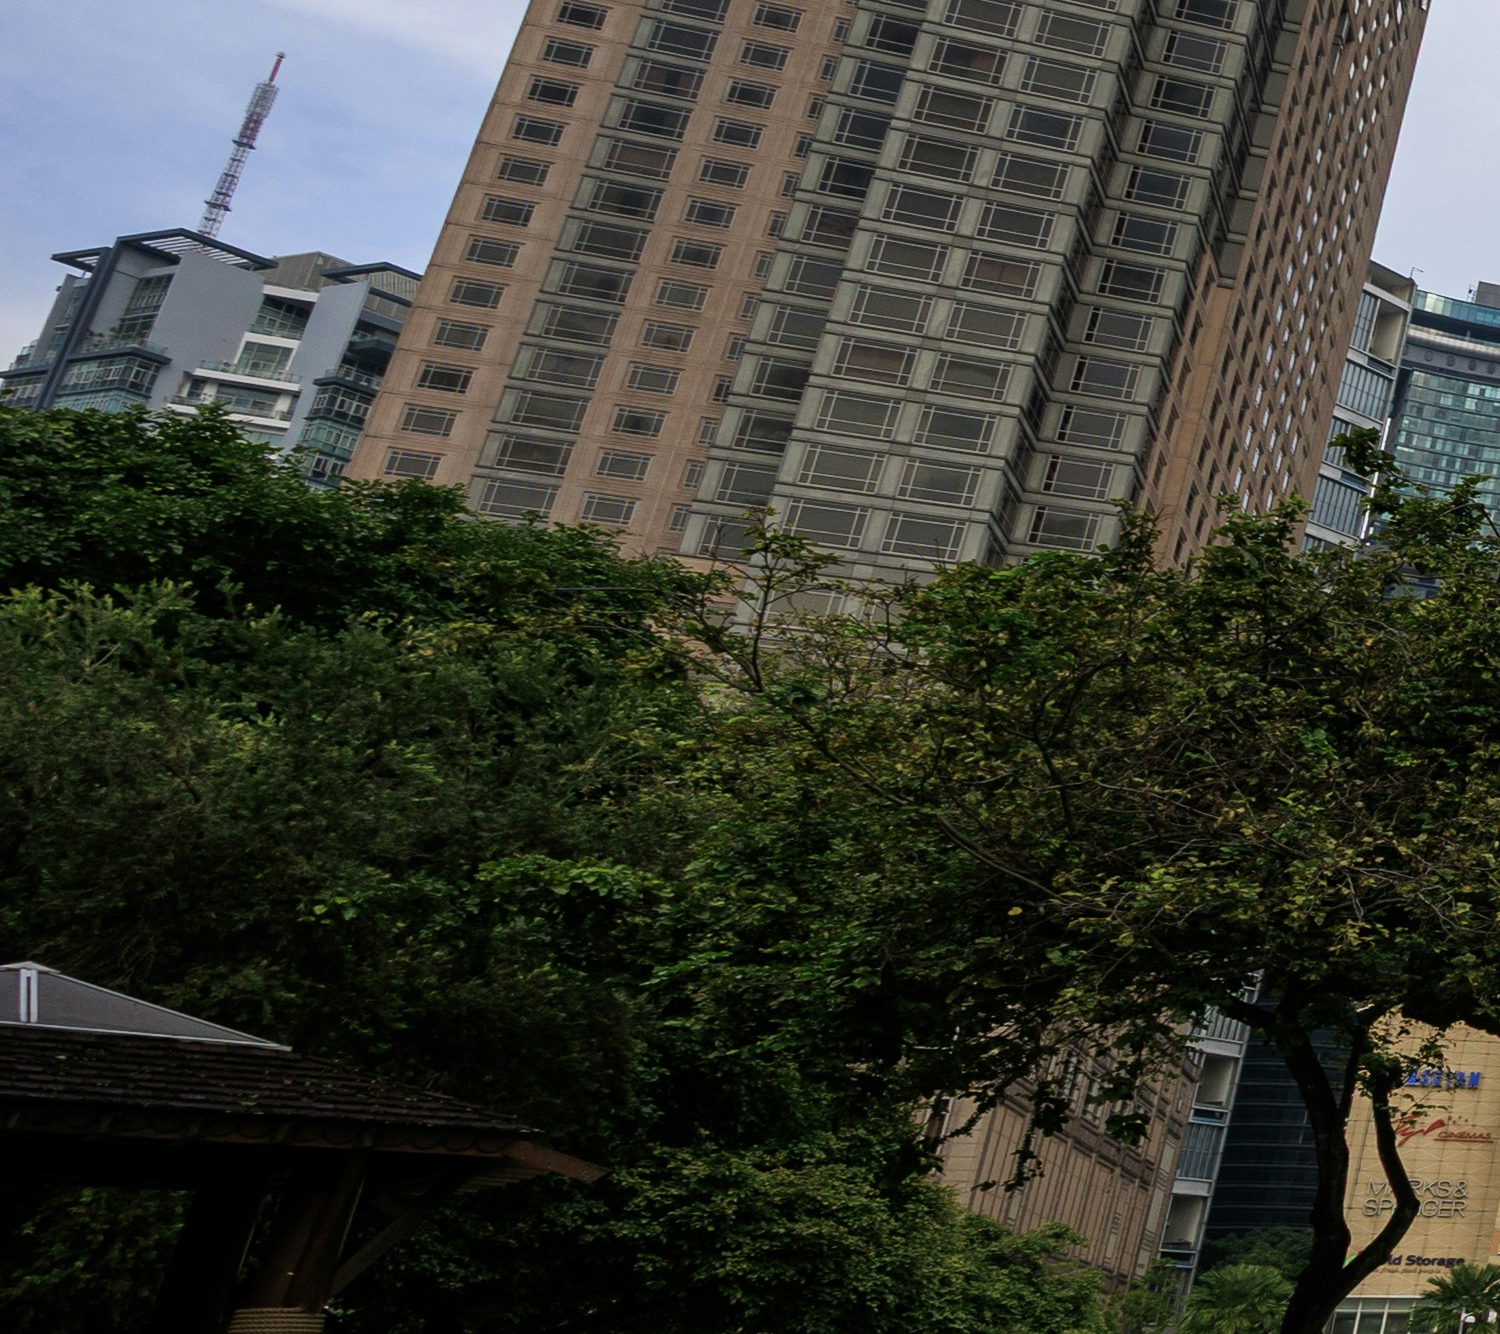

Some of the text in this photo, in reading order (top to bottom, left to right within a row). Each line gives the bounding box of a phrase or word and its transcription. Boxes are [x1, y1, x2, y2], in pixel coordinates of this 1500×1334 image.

[1454, 1179, 1469, 1198] &
[1363, 1199, 1466, 1217] SPCER
[1406, 1255, 1466, 1268] Storage
